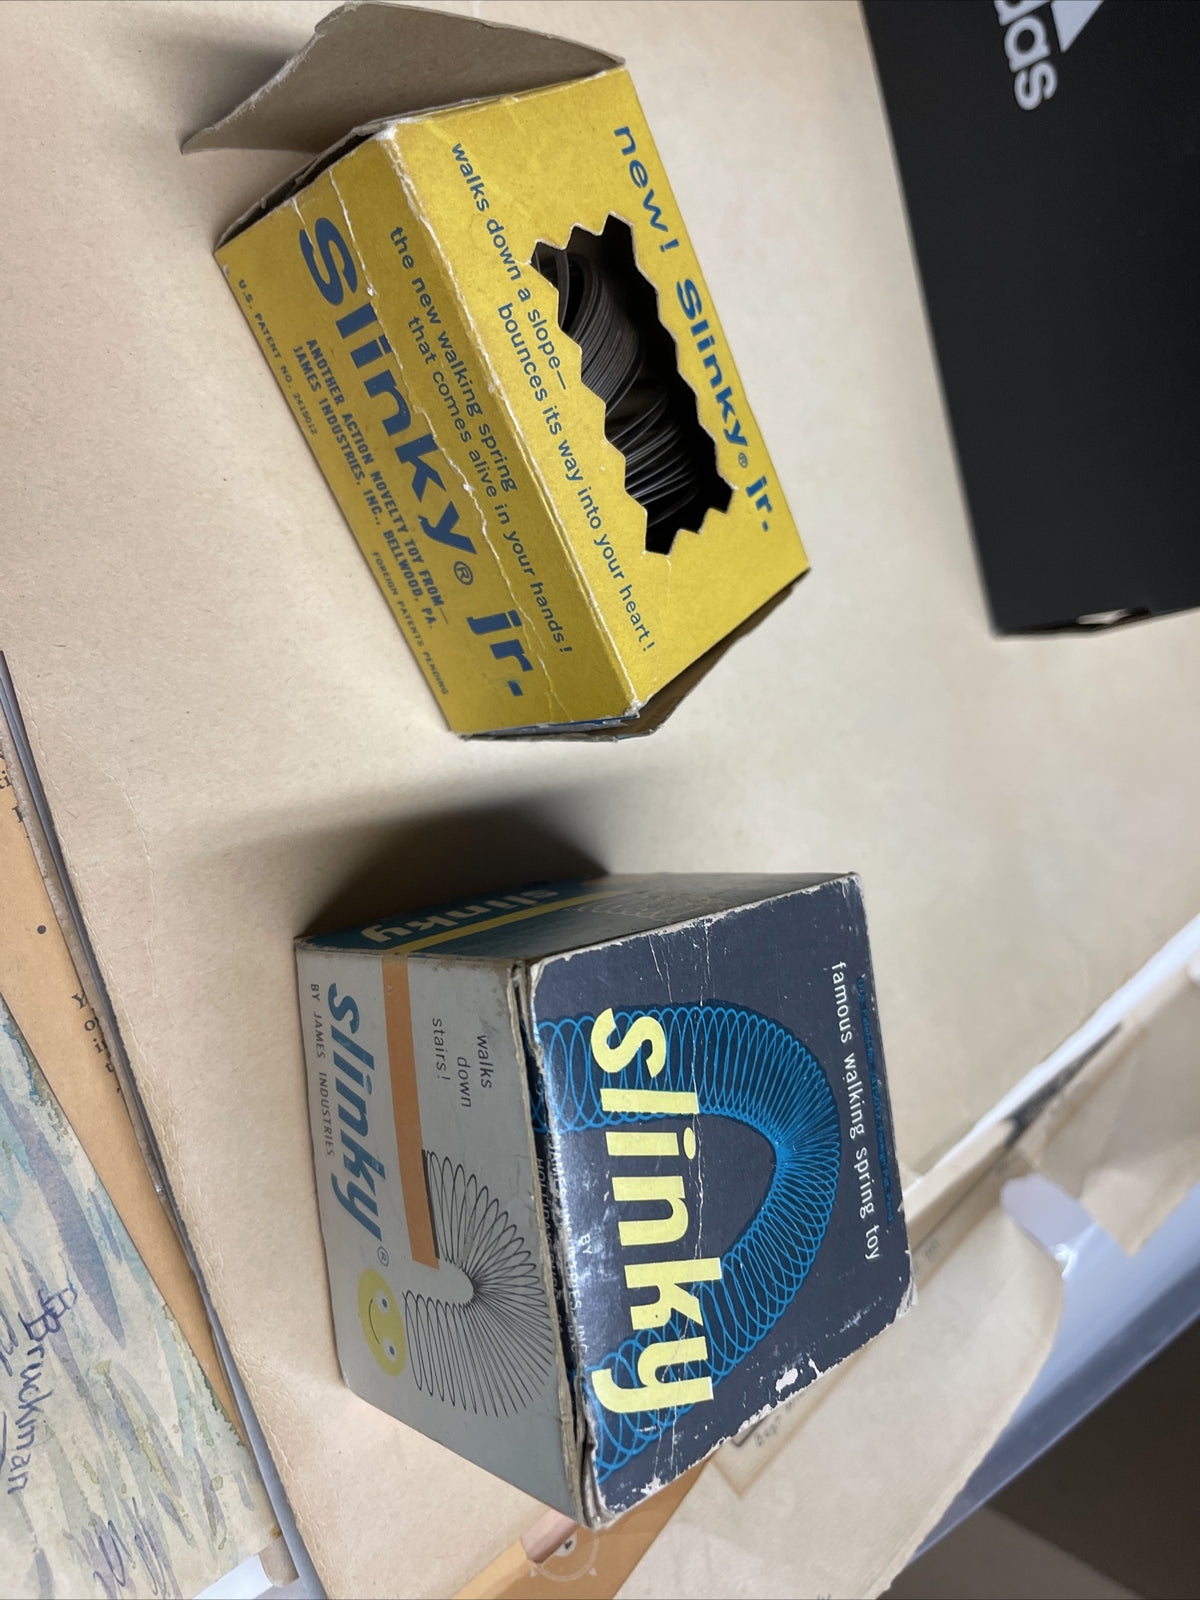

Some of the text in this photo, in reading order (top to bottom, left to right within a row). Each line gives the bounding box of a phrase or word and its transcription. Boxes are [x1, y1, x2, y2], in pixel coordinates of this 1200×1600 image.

[452, 143, 489, 212] walks
[487, 219, 522, 281] down
[518, 288, 530, 302] a
[254, 313, 282, 360] PATENT
[293, 392, 318, 435] 2415012
[390, 226, 517, 491] the new walking spring
[613, 126, 680, 253] new!
[745, 475, 773, 532] jr.
[294, 346, 322, 393] JAMES
[319, 398, 366, 486] INDUSTRIES,
[383, 530, 423, 603] BELLWOOD,
[421, 608, 434, 629] PA.
[307, 339, 344, 407] ANOTHER
[343, 413, 374, 466] ACTION
[370, 470, 410, 535] NOVELTY
[404, 537, 421, 566] TOY
[408, 315, 573, 653] that comes alive in your hands!
[497, 304, 656, 653] bounces its way into your heart!
[372, 552, 451, 695] FOREIGN PATENTS PENDING
[467, 610, 533, 697] jr.
[361, 888, 558, 943] slinky
[310, 983, 336, 1156] BY JAMES INDUSTRIES
[432, 1017, 450, 1080] stairs!
[457, 1056, 472, 1108] down
[476, 1034, 492, 1089] walks
[831, 961, 881, 1261] famous walking spring toy
[578, 1233, 592, 1255] BY
[591, 1008, 722, 1414] slinky
